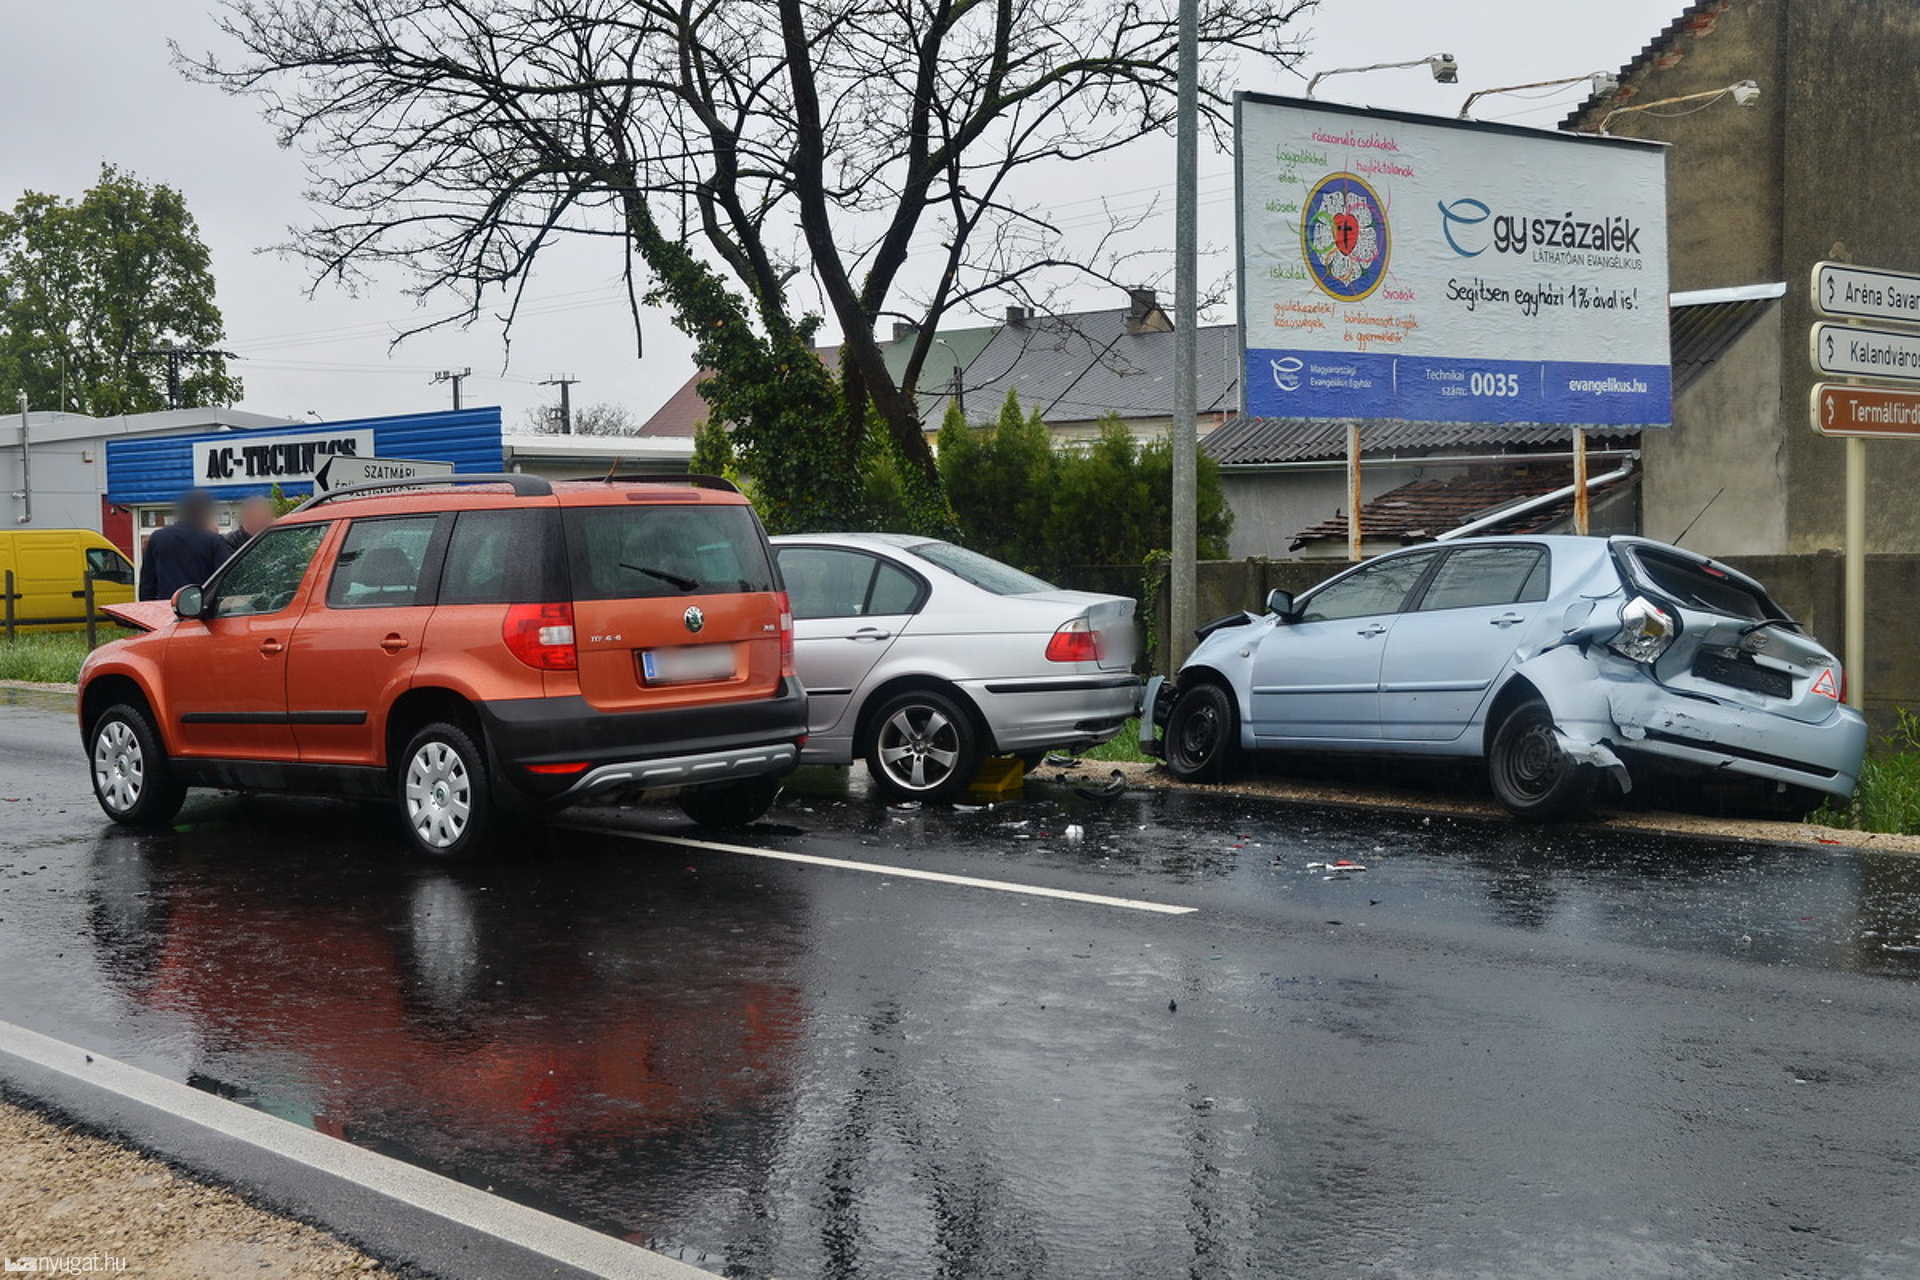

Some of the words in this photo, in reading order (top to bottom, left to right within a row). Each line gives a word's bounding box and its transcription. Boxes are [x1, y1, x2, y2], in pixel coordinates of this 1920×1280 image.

[1532, 249, 1584, 267] LÁTHATÓAN
[1587, 254, 1642, 271] EVANGÉLIKUS
[1446, 277, 1509, 311] Segítsen
[1514, 283, 1564, 316] egyházi
[1620, 287, 1639, 310] is!
[1845, 281, 1883, 306] Aréna
[1425, 368, 1465, 381] Technikai
[1470, 372, 1519, 397] 0035
[1569, 378, 1648, 395] evangelikus.hu
